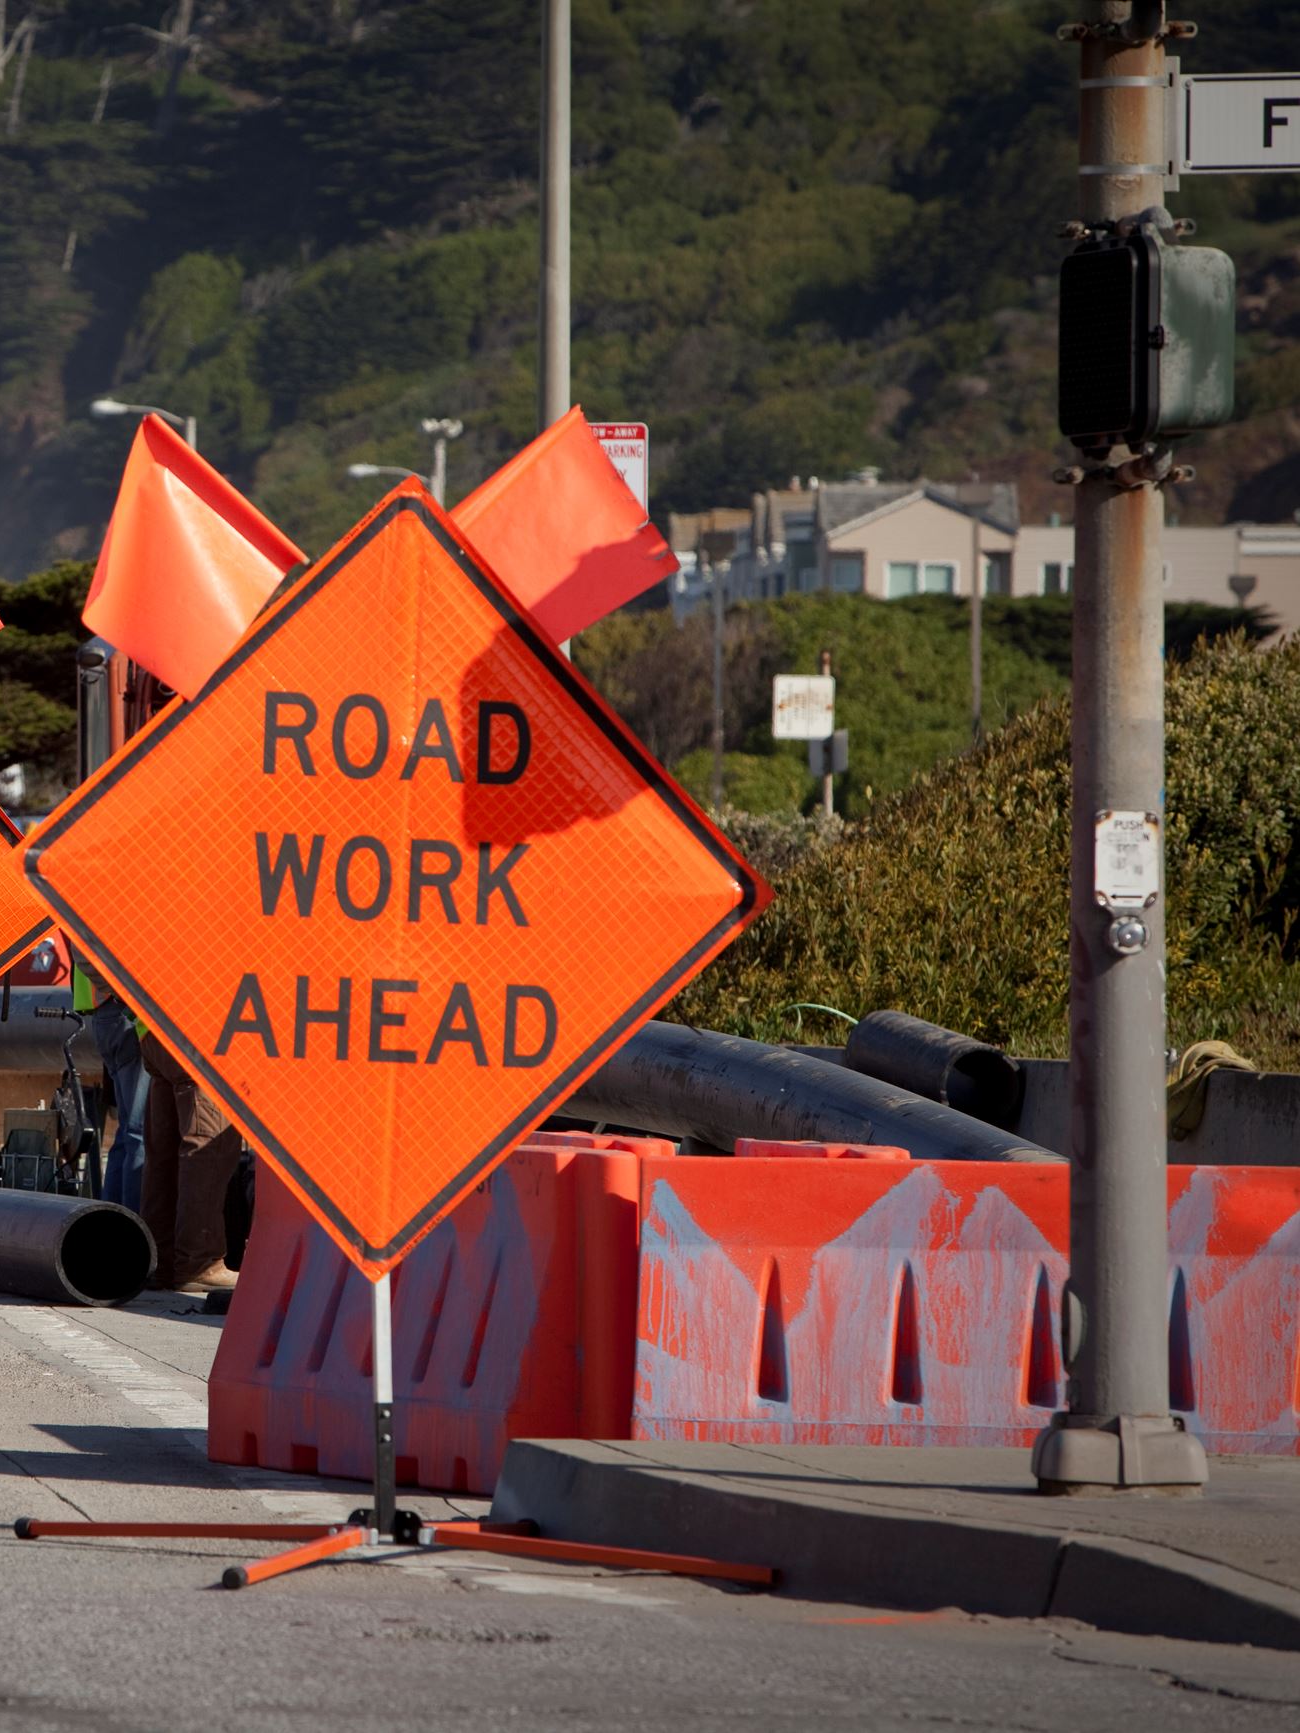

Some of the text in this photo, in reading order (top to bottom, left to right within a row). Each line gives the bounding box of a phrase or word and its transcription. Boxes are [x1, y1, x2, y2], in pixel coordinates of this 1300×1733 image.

[1263, 97, 1300, 148] F
[263, 691, 532, 786] ROAD
[1113, 820, 1144, 830] PUSH
[255, 831, 532, 928] WORK
[213, 972, 559, 1069] AHEAD
